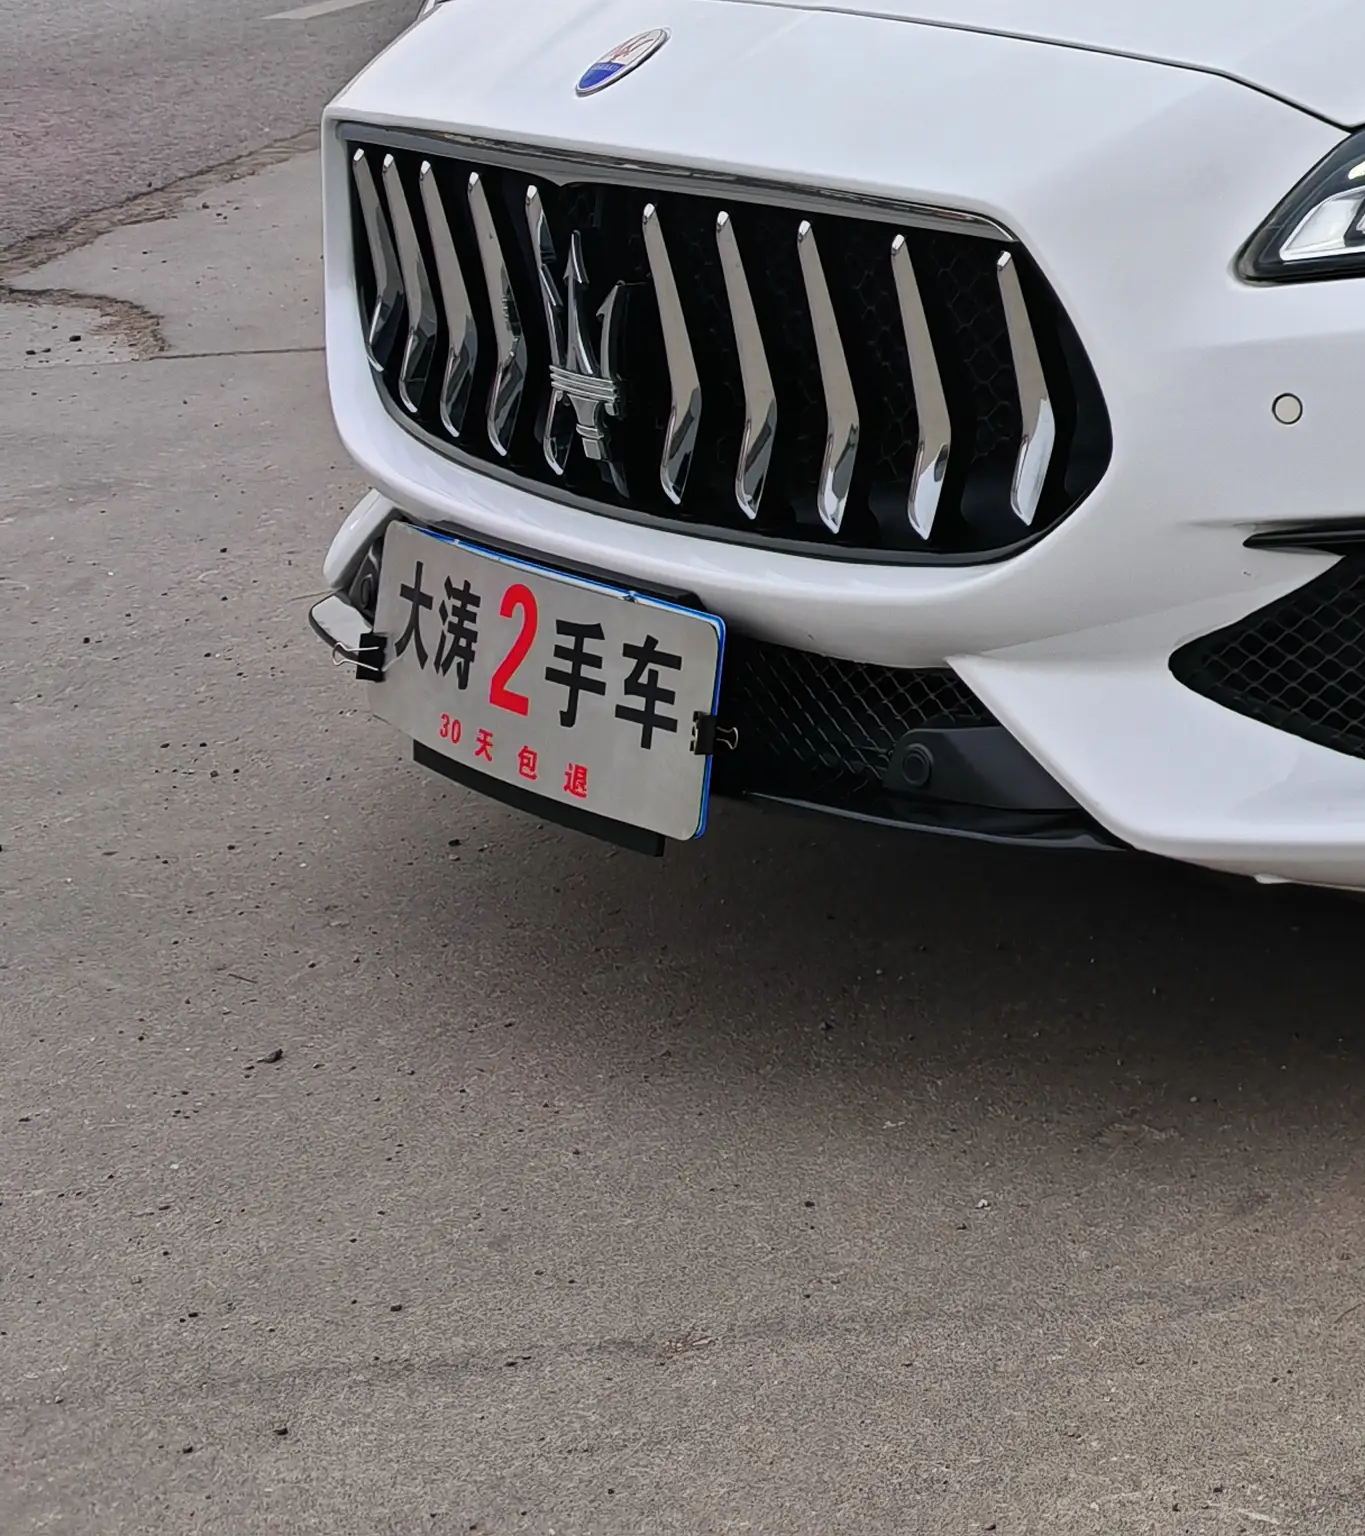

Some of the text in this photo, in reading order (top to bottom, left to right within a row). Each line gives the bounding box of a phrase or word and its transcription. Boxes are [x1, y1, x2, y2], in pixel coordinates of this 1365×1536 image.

[395, 561, 683, 750] 大涛2手车
[439, 713, 589, 799] 30天包退
